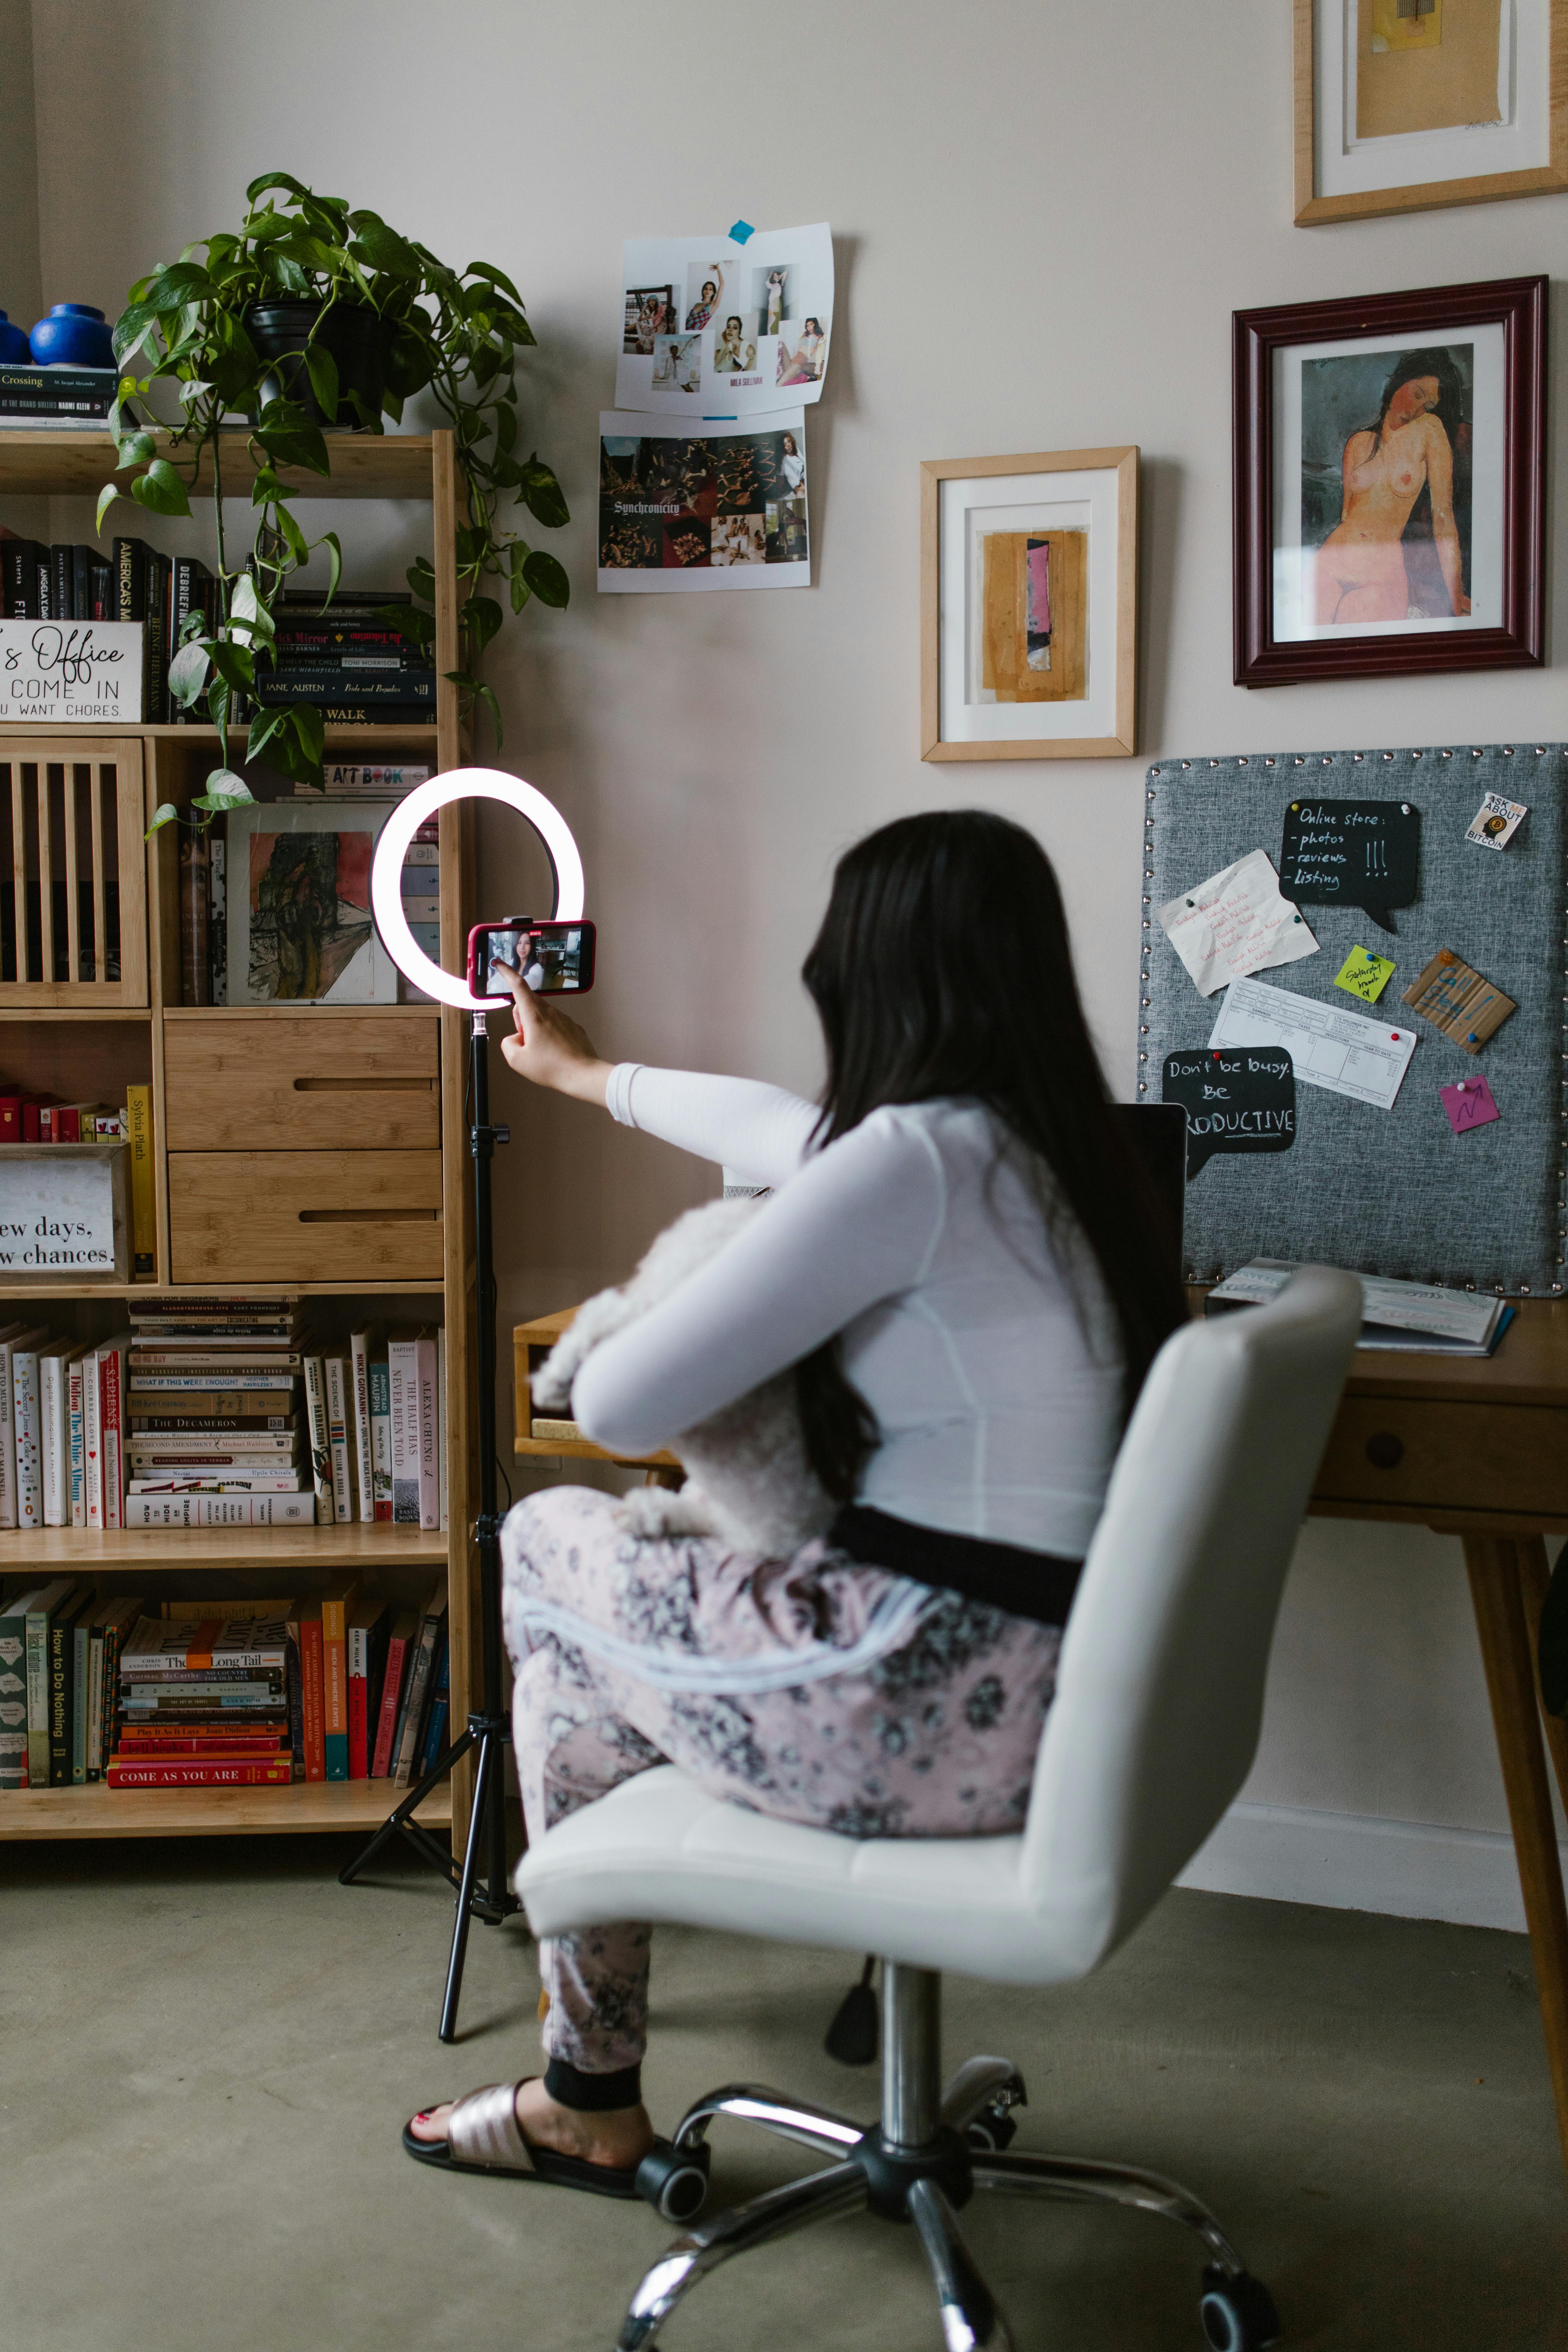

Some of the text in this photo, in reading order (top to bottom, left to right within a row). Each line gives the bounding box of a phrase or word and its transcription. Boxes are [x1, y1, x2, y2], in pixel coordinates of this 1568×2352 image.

[2, 375, 43, 388] Crossing
[58, 402, 90, 410] NAOMI KLEIN
[614, 501, 680, 516] Synchronicity
[120, 542, 132, 605] AMERICA'S
[152, 617, 161, 651] BEING
[296, 633, 328, 644] Mirror
[350, 633, 388, 644] Tolentino
[32, 626, 124, 684] Office
[11, 679, 118, 699] COME IN
[266, 683, 325, 692] JANE AUSTEN
[345, 683, 401, 693] Pride and Prejudice
[20, 704, 122, 716] WANT CHORES.
[326, 709, 366, 720] WALK
[333, 767, 404, 785] ART BOOK
[1300, 806, 1337, 825] Online
[1484, 803, 1522, 822] ABOUT
[1510, 804, 1525, 816] ME
[1467, 831, 1504, 849] BITCOIN
[1294, 868, 1340, 891] Listing
[1345, 963, 1381, 982] Saturday
[1438, 967, 1473, 993] Call
[1252, 1008, 1271, 1017] EARNINGS
[1343, 1018, 1362, 1028] HOLDINGS
[1325, 1032, 1350, 1044] DEDUCTIONS
[1168, 1057, 1290, 1080] Don't busy.
[134, 1100, 146, 1160] Sylvia Plath
[1187, 1110, 1293, 1135] RODUCTIVE
[35, 1216, 92, 1243] days,
[23, 1244, 115, 1264] chances.
[106, 1369, 117, 1425] SAPIENS
[358, 1378, 367, 1415] GIOVANNI
[371, 1374, 380, 1411] MAUPIN
[177, 1418, 236, 1427] DECAMERON
[314, 1404, 325, 1445] BARRACOON
[392, 1370, 404, 1466] NEVER BEEN TOLD
[407, 1379, 418, 1455] THE HALF HAS
[423, 1379, 432, 1462] ALEXA CHUNG
[70, 1376, 83, 1501] Didion The White Album
[27, 1633, 44, 1650] black
[53, 1629, 63, 1654] How
[28, 1652, 42, 1673] nature
[54, 1658, 63, 1670] to
[165, 1655, 261, 1668] The Long Tail
[54, 1673, 64, 1689] Do
[53, 1692, 64, 1737] Nothing
[152, 1743, 184, 1752] hooks
[120, 1771, 239, 1781] COME AS YOU ARE
